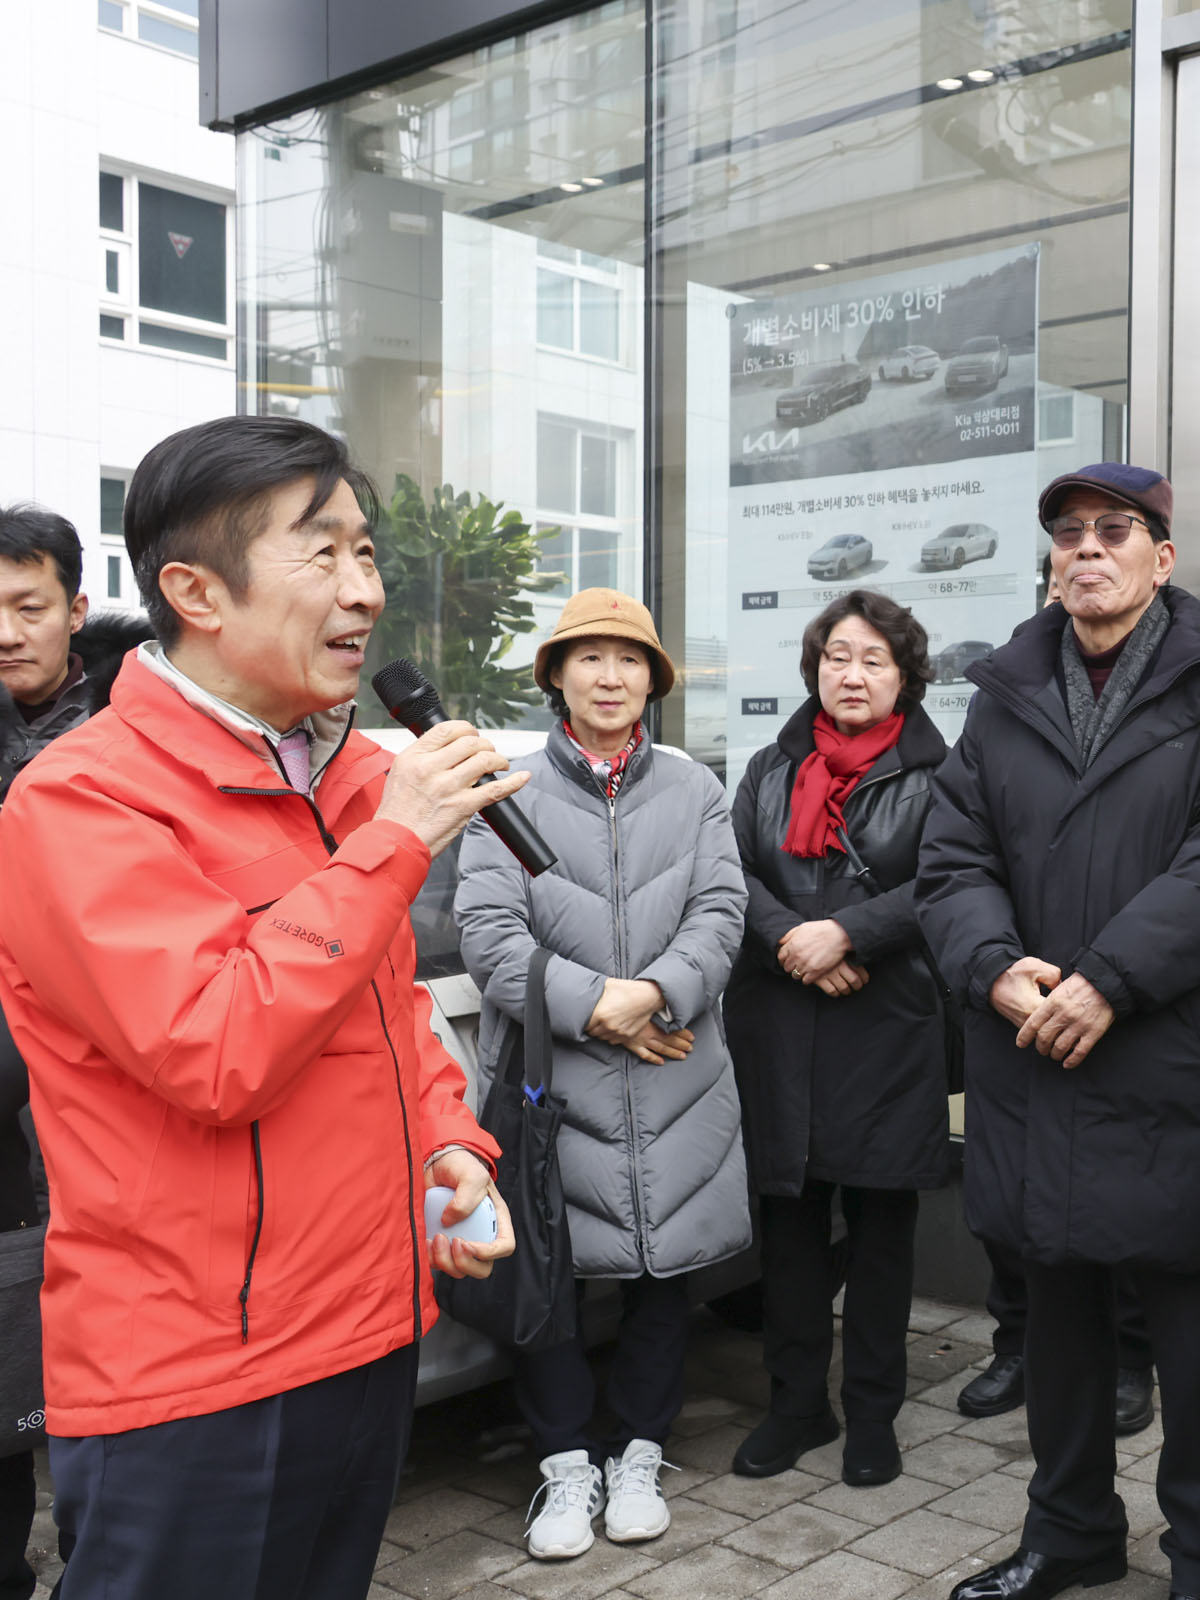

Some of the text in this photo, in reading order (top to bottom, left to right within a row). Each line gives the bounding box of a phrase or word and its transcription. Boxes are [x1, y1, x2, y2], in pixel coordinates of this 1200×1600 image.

[743, 283, 947, 346] 개별소비세 30% 인하
[743, 357, 762, 376] (5%
[955, 414, 972, 427] Kia
[960, 421, 1020, 442] 02-511-0011
[742, 480, 985, 519] 최대 114만원, 개별소비세 30% 인하 혜택을 놓치지 마세요.
[270, 918, 325, 947] GORE-TEX
